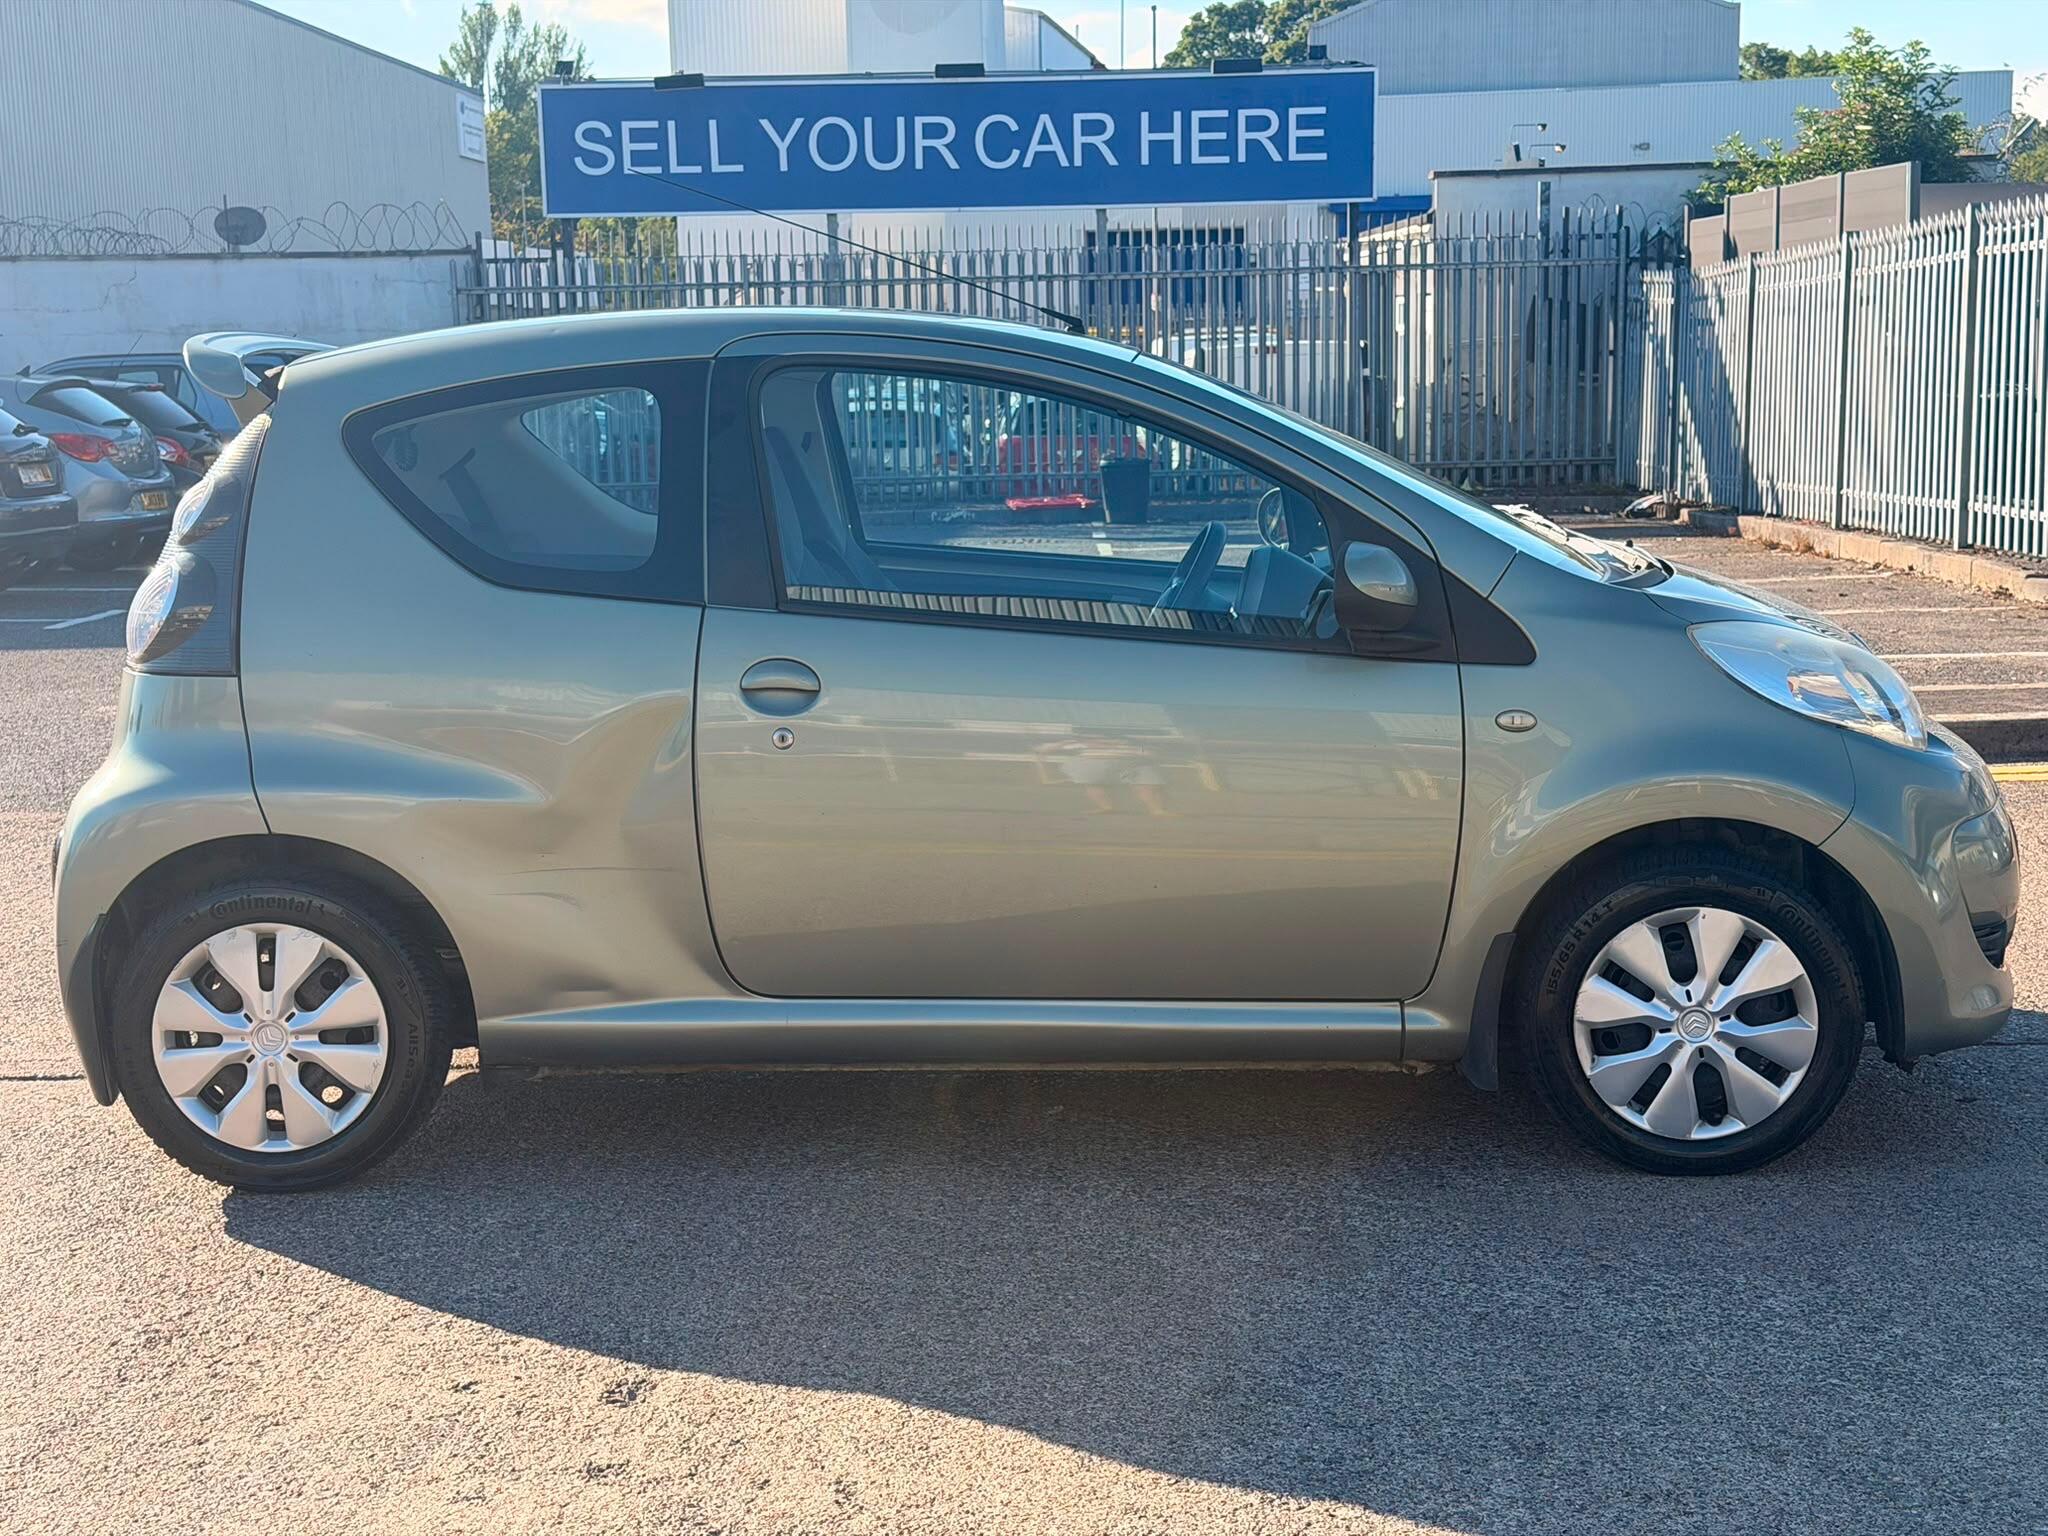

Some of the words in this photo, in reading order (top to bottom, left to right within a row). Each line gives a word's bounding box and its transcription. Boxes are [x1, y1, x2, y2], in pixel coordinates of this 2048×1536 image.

[573, 119, 744, 176] SELL
[758, 115, 960, 172] YOUR
[974, 112, 1119, 169] CAR
[1140, 106, 1328, 165] HERE
[208, 894, 312, 919] Continental
